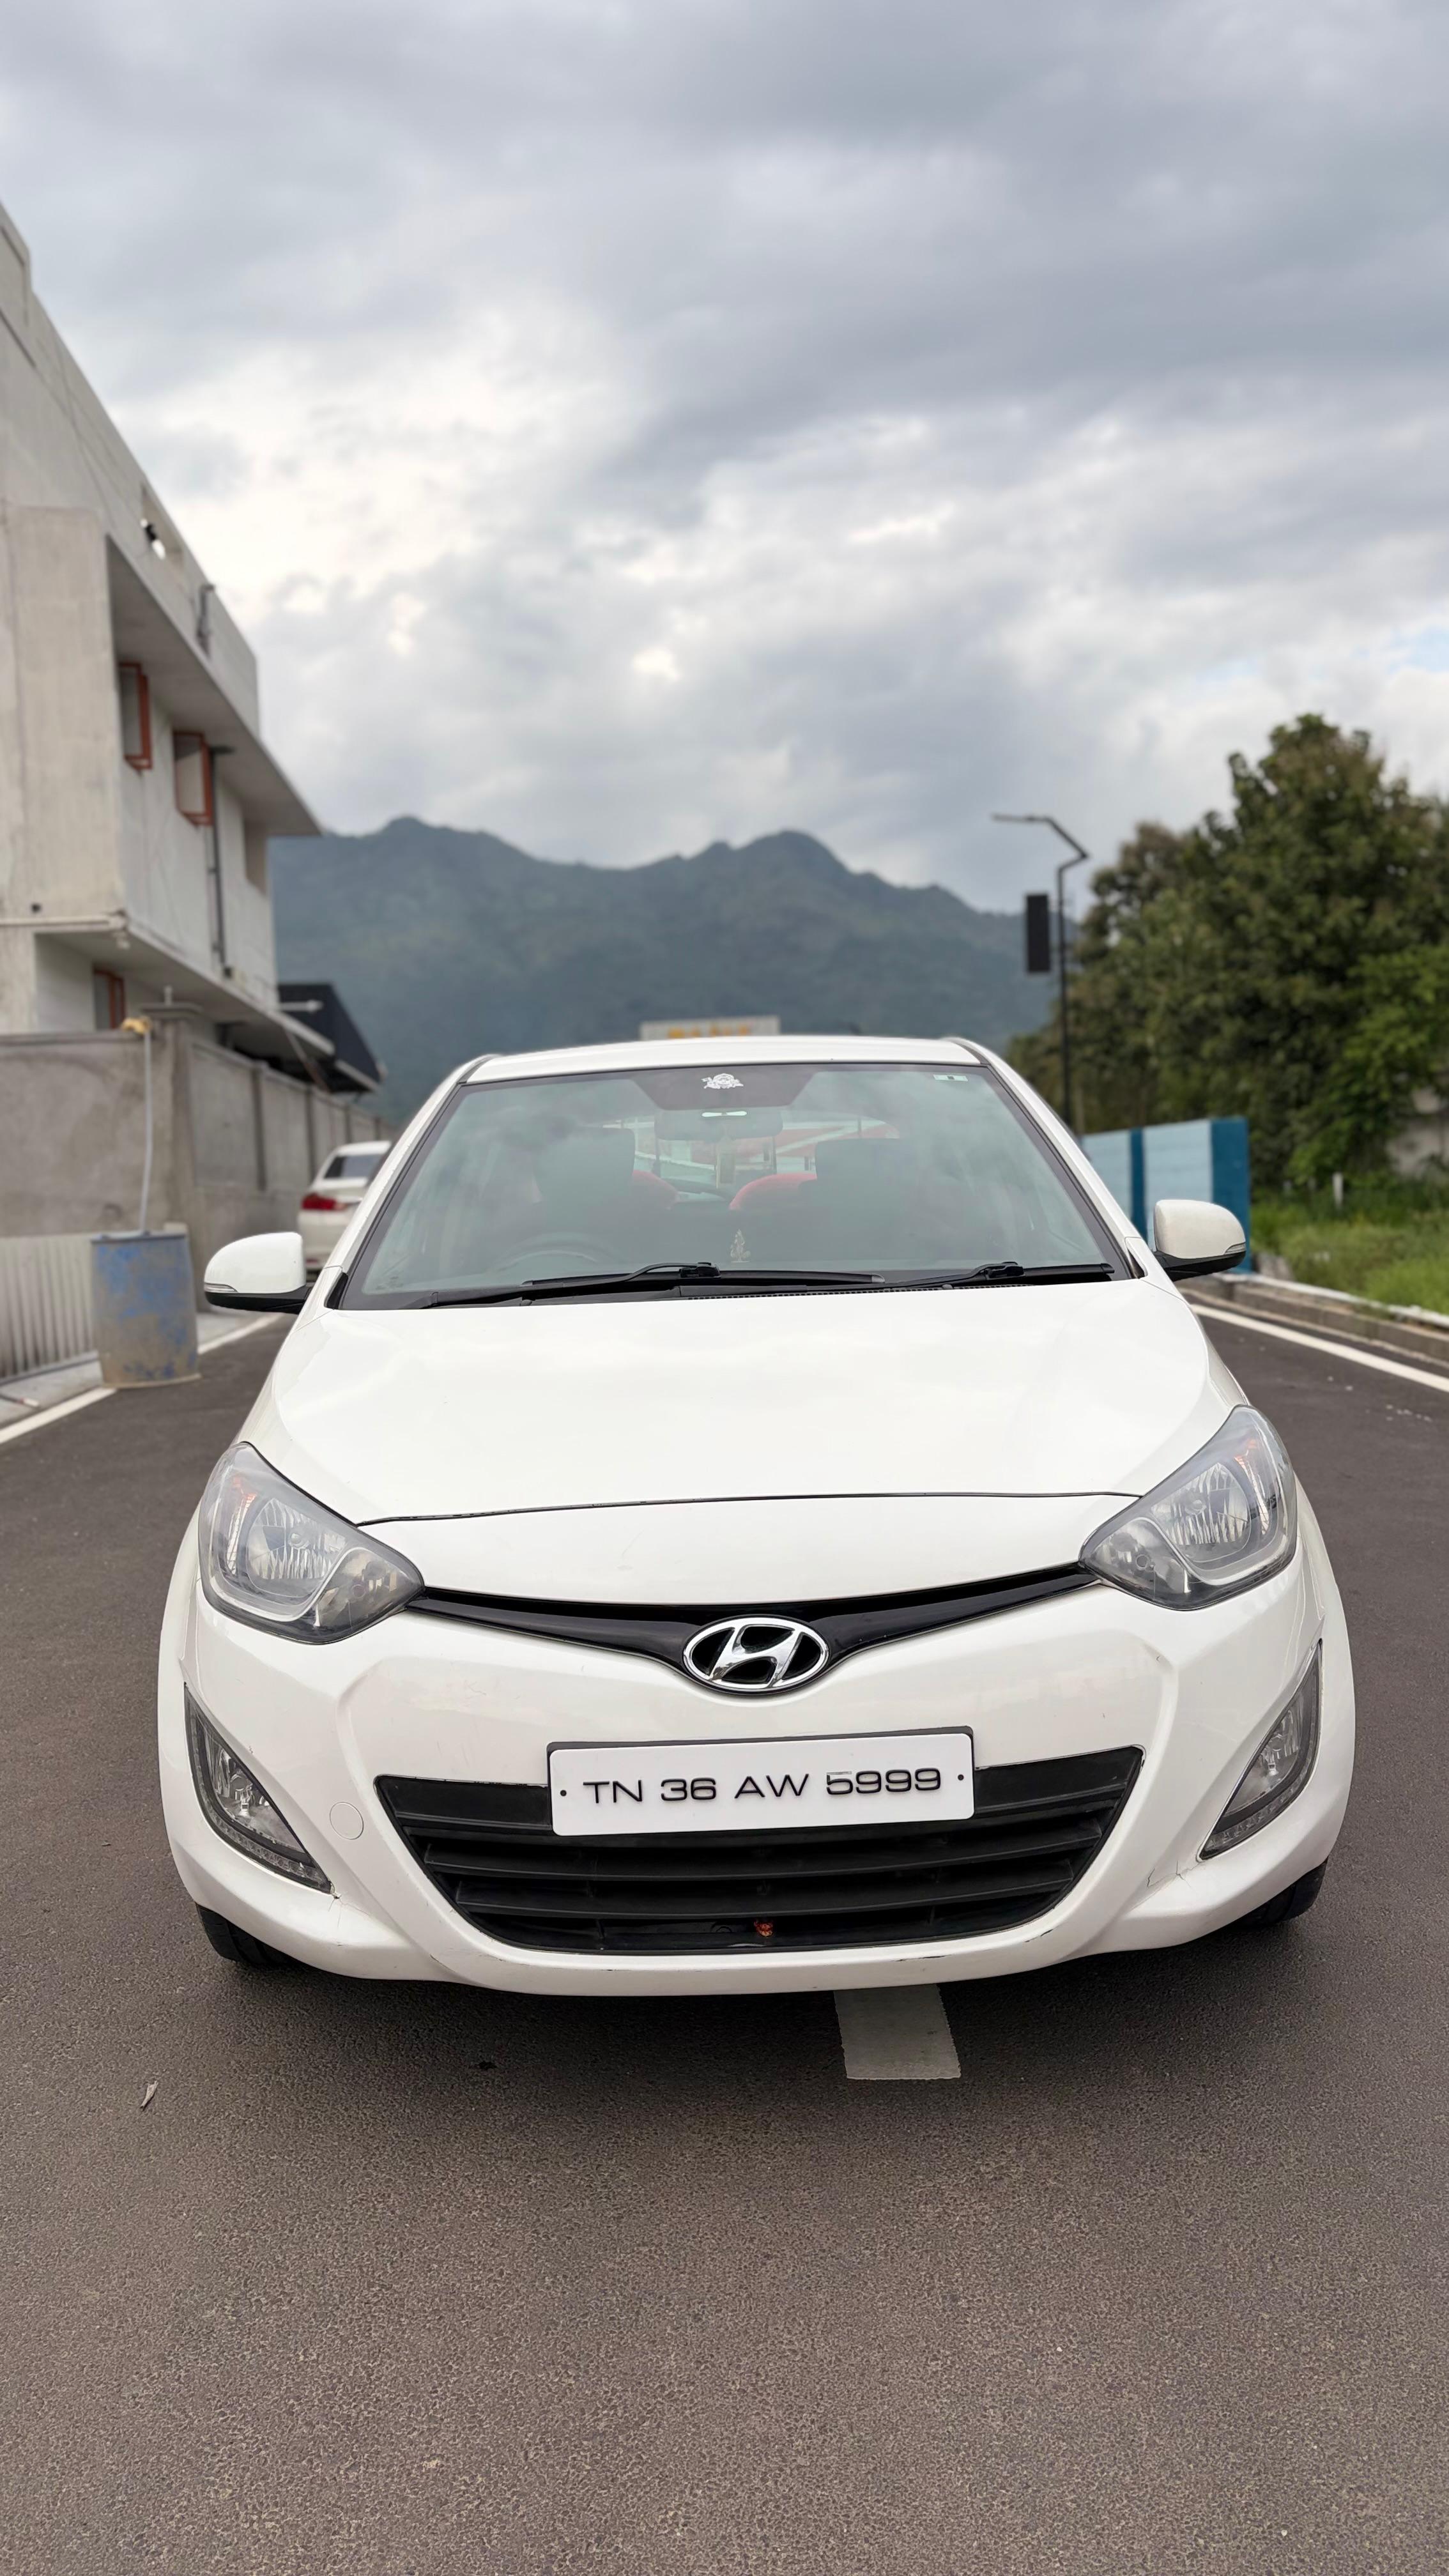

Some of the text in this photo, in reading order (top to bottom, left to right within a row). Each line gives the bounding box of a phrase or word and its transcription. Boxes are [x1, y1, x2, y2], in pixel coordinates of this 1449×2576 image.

[583, 1767, 942, 1804] TN 36 AW 5999
